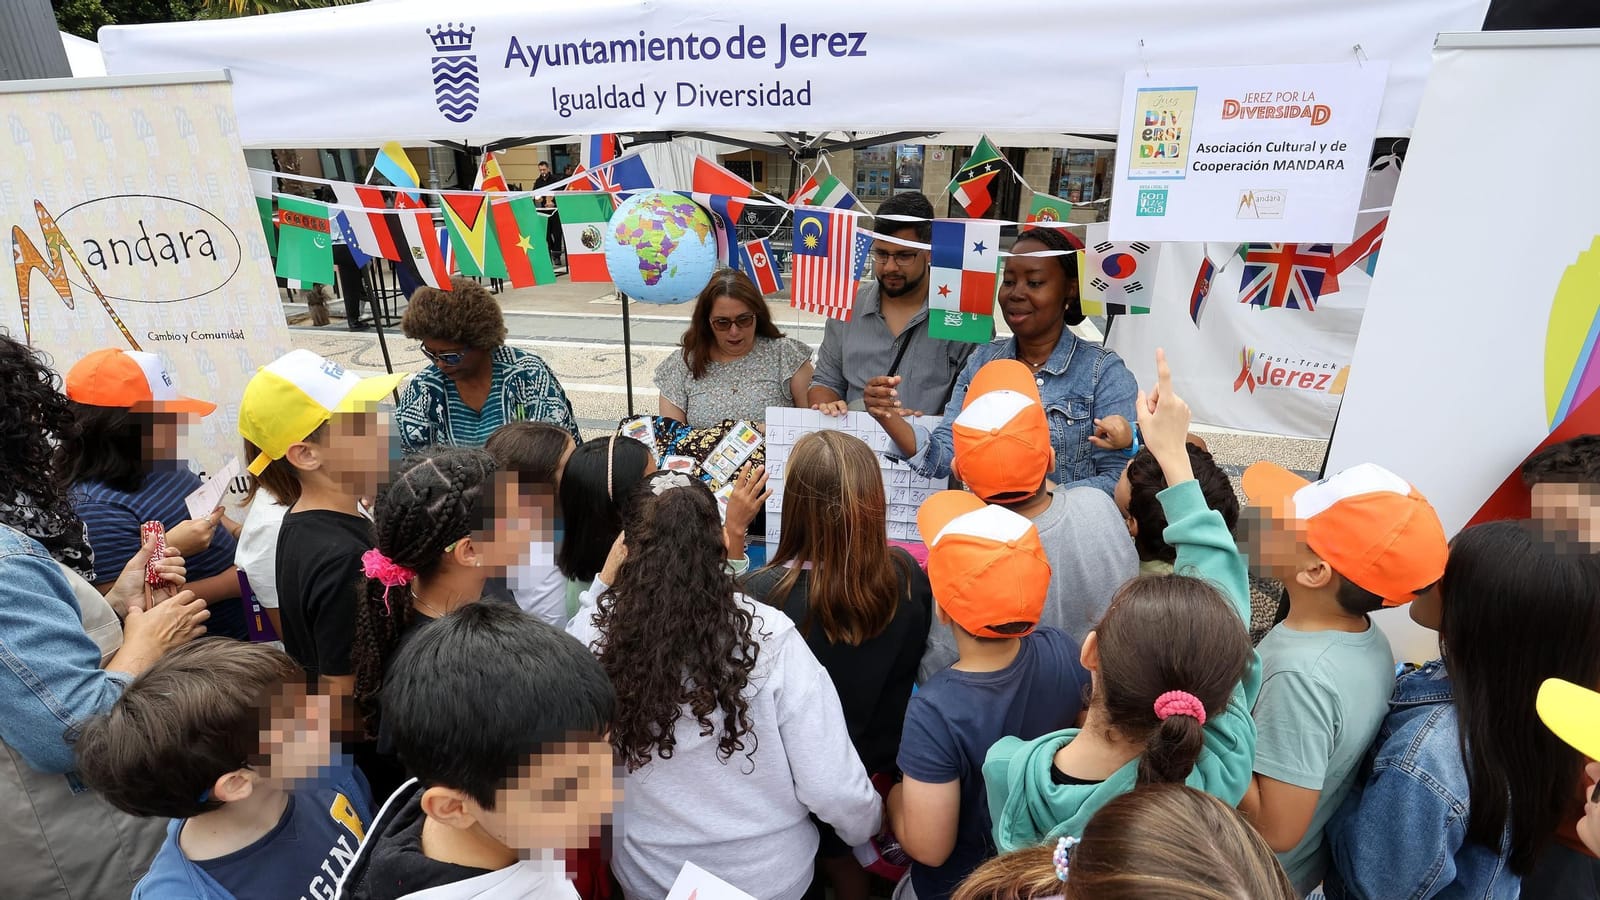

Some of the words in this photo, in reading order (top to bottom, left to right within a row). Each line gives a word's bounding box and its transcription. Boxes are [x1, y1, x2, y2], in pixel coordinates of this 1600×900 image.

[504, 30, 721, 77] Ayuntamiento
[726, 25, 765, 60] de
[775, 23, 867, 69] Jerez
[552, 84, 645, 117] Igualdad
[654, 91, 668, 115] y
[676, 80, 812, 109] Diversidad
[1242, 92, 1273, 104] JEREZ
[1275, 91, 1299, 103] POR
[1302, 91, 1315, 102] LA
[1140, 143, 1180, 158] DAD
[1196, 141, 1262, 154] Asociación
[1265, 140, 1316, 153] Cultural
[1319, 143, 1328, 154] y
[1330, 140, 1347, 152] de
[1192, 159, 1269, 174] Cooperación
[1272, 159, 1345, 171] MANDARA
[12, 199, 217, 351] Mandara
[148, 330, 182, 342] Cambio
[182, 334, 189, 343] y
[191, 329, 245, 341] Comunidad
[1258, 352, 1338, 370] Fast-Track
[1256, 361, 1332, 391] Jerez
[769, 431, 776, 442] 4
[787, 430, 795, 441] 5
[767, 464, 782, 476] 17
[893, 471, 907, 484] 22
[892, 489, 906, 501] 29
[911, 490, 926, 503] 30
[891, 505, 906, 516] 37
